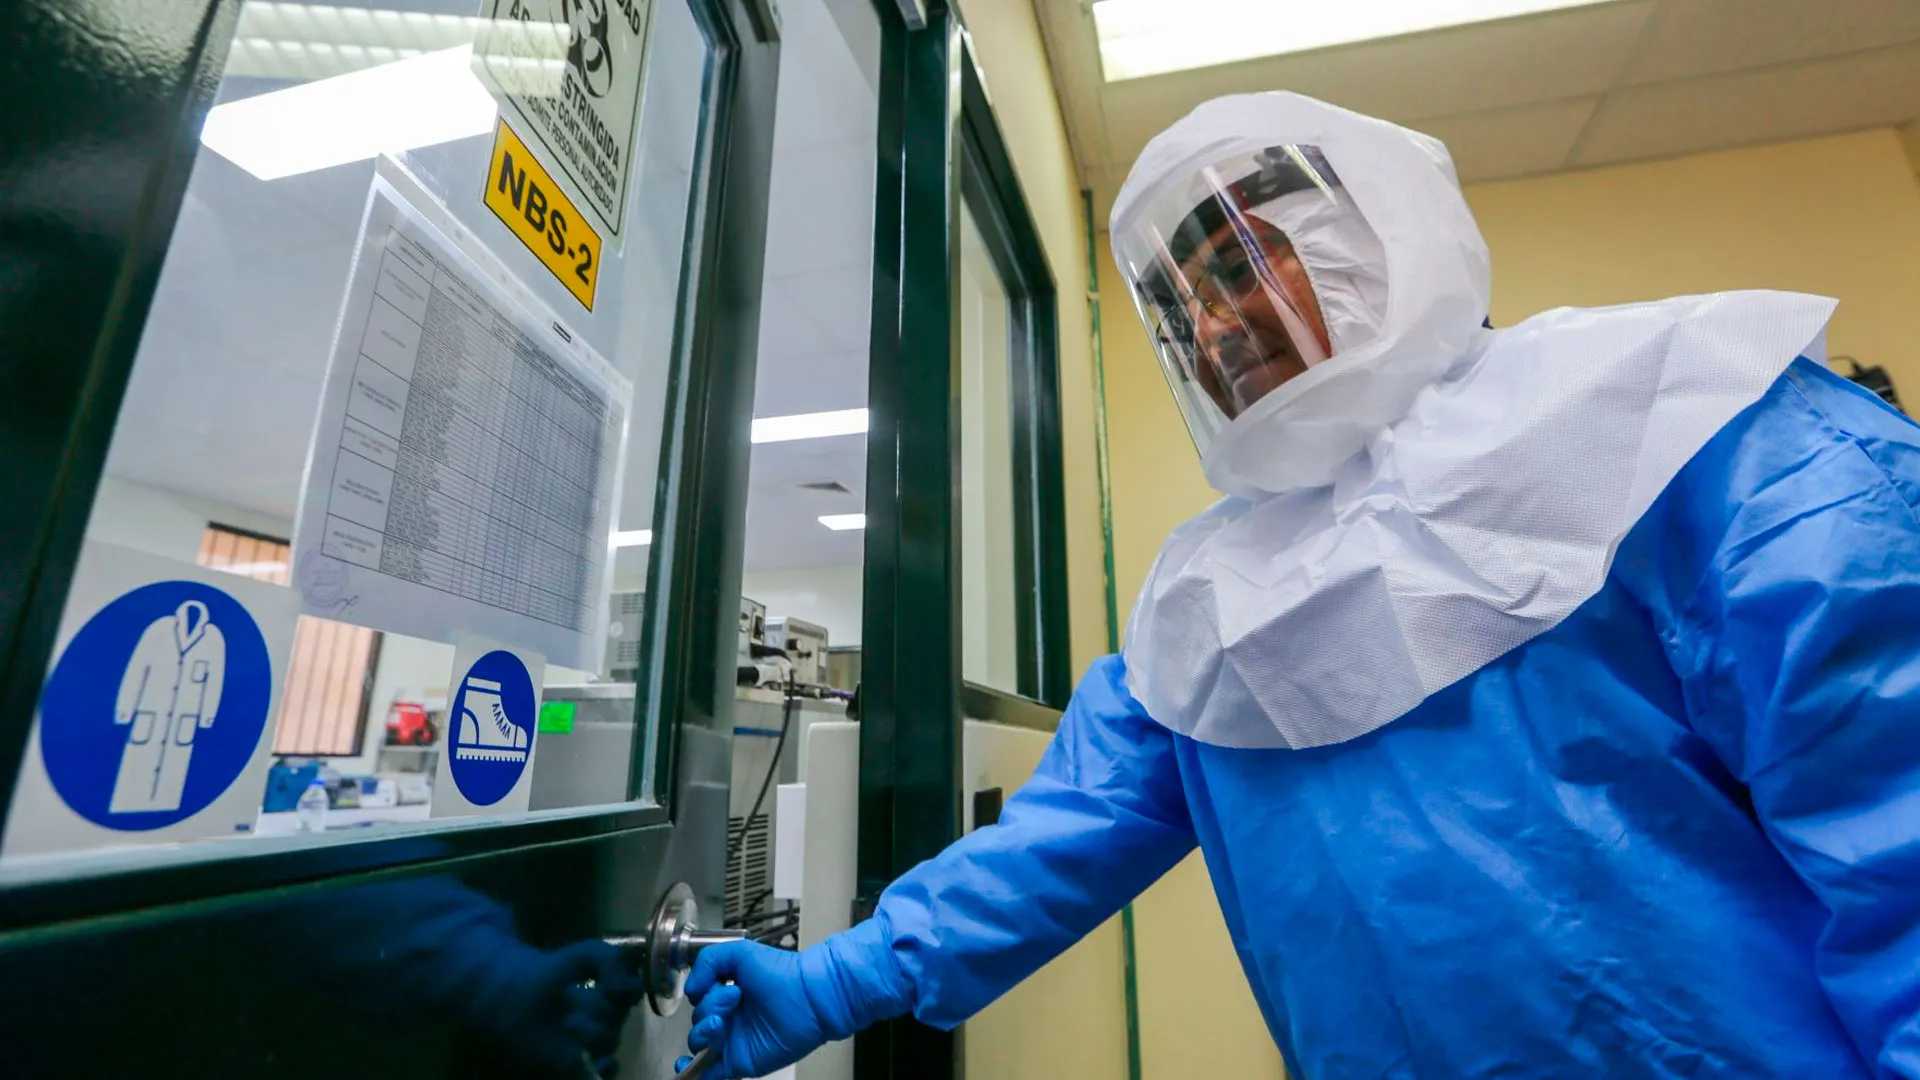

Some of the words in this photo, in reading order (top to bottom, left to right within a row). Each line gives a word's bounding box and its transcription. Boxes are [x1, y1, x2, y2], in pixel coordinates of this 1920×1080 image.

[498, 151, 592, 286] NBS-2
[551, 121, 580, 172] PERSONAL
[581, 160, 613, 215] AUTORIZADO
